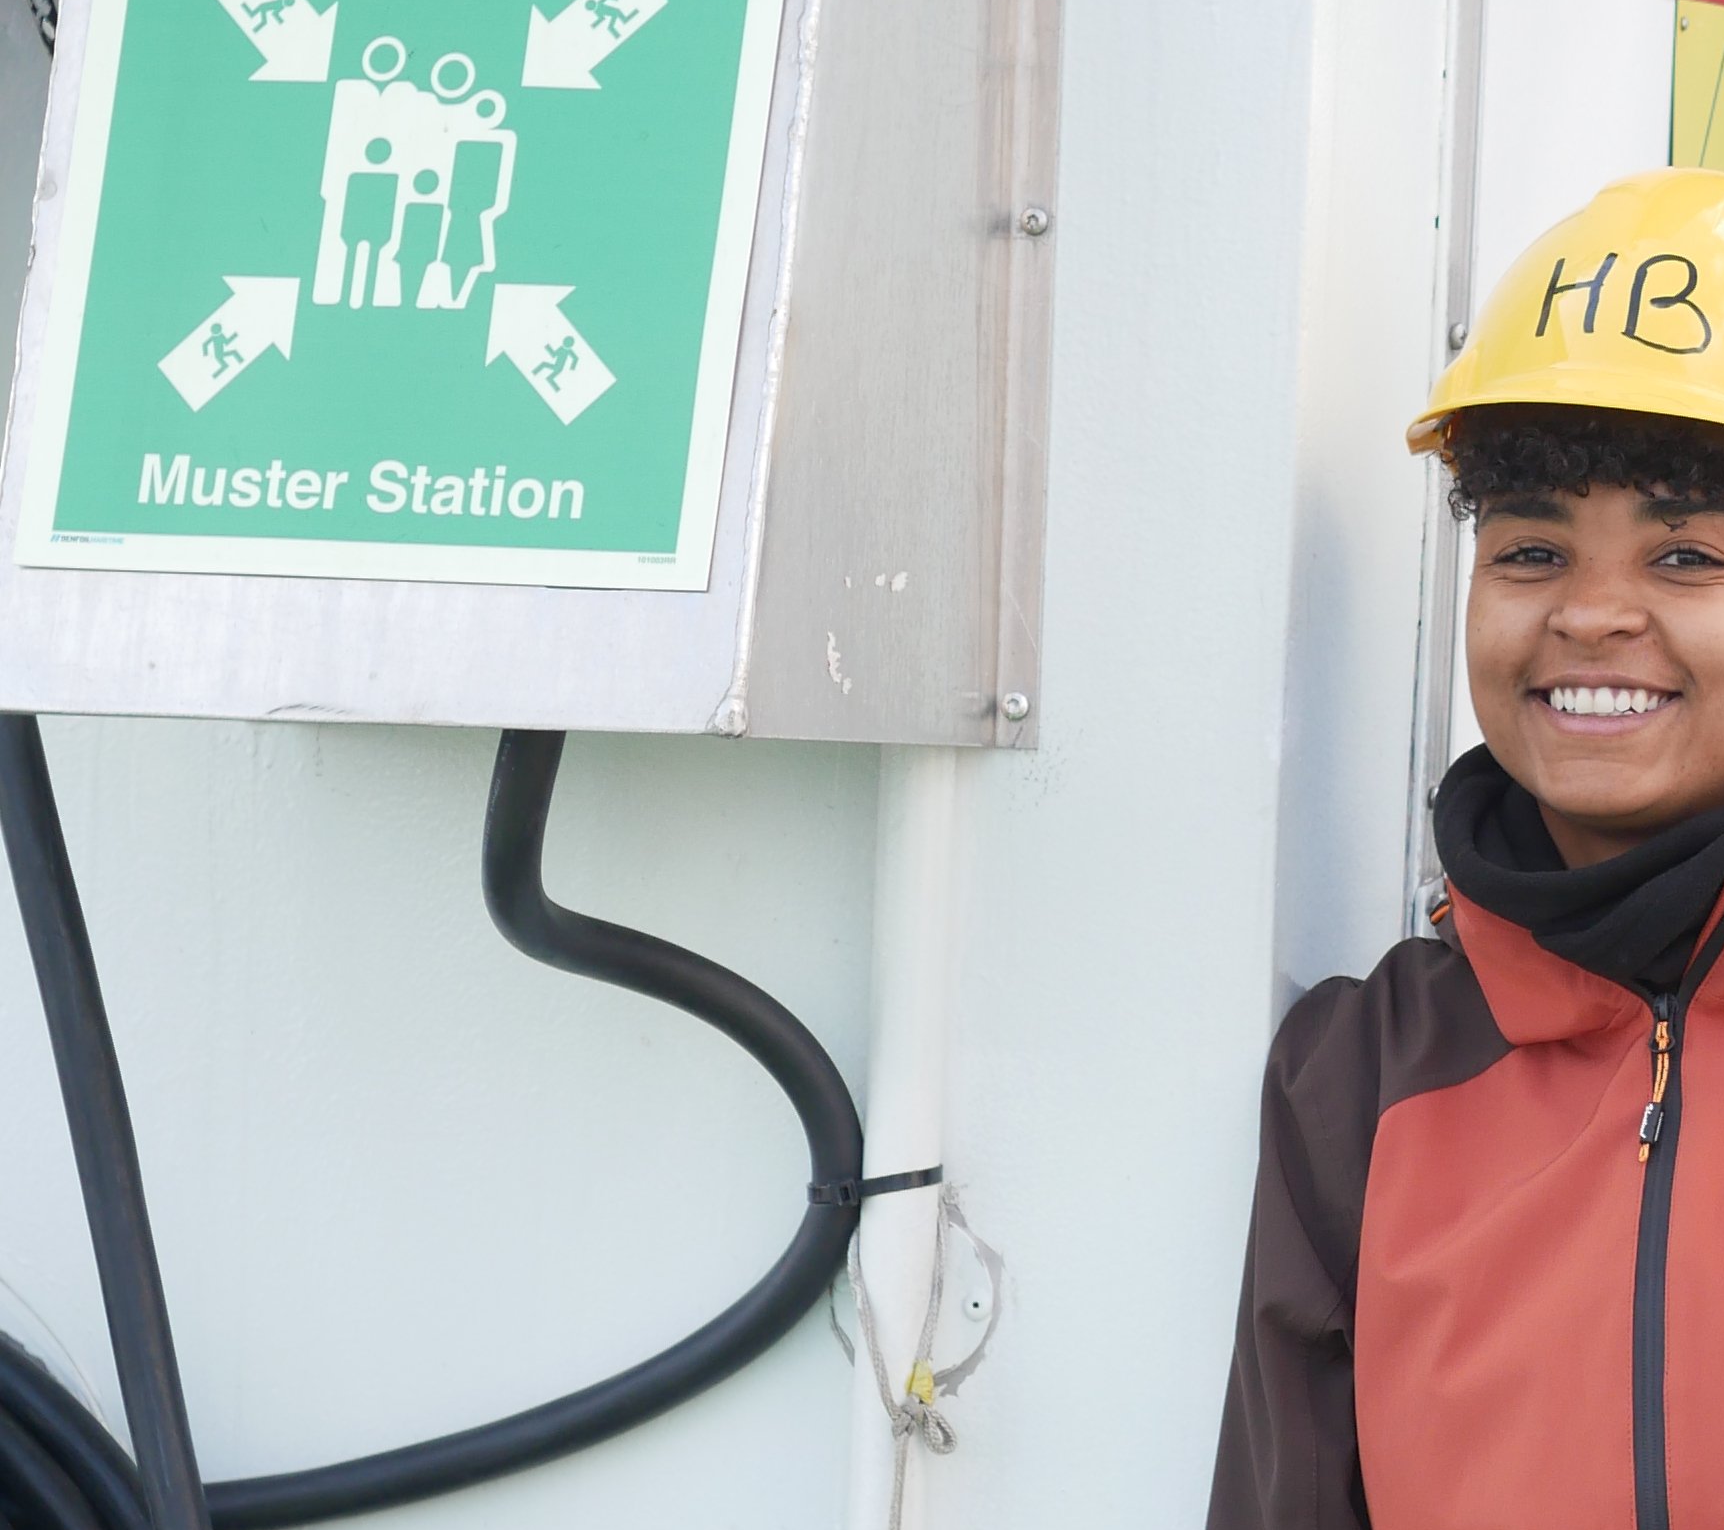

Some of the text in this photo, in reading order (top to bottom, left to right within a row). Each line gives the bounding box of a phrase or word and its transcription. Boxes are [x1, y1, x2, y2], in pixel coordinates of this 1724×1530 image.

[1534, 252, 1712, 355] HB
[137, 453, 585, 520] Muster Station
